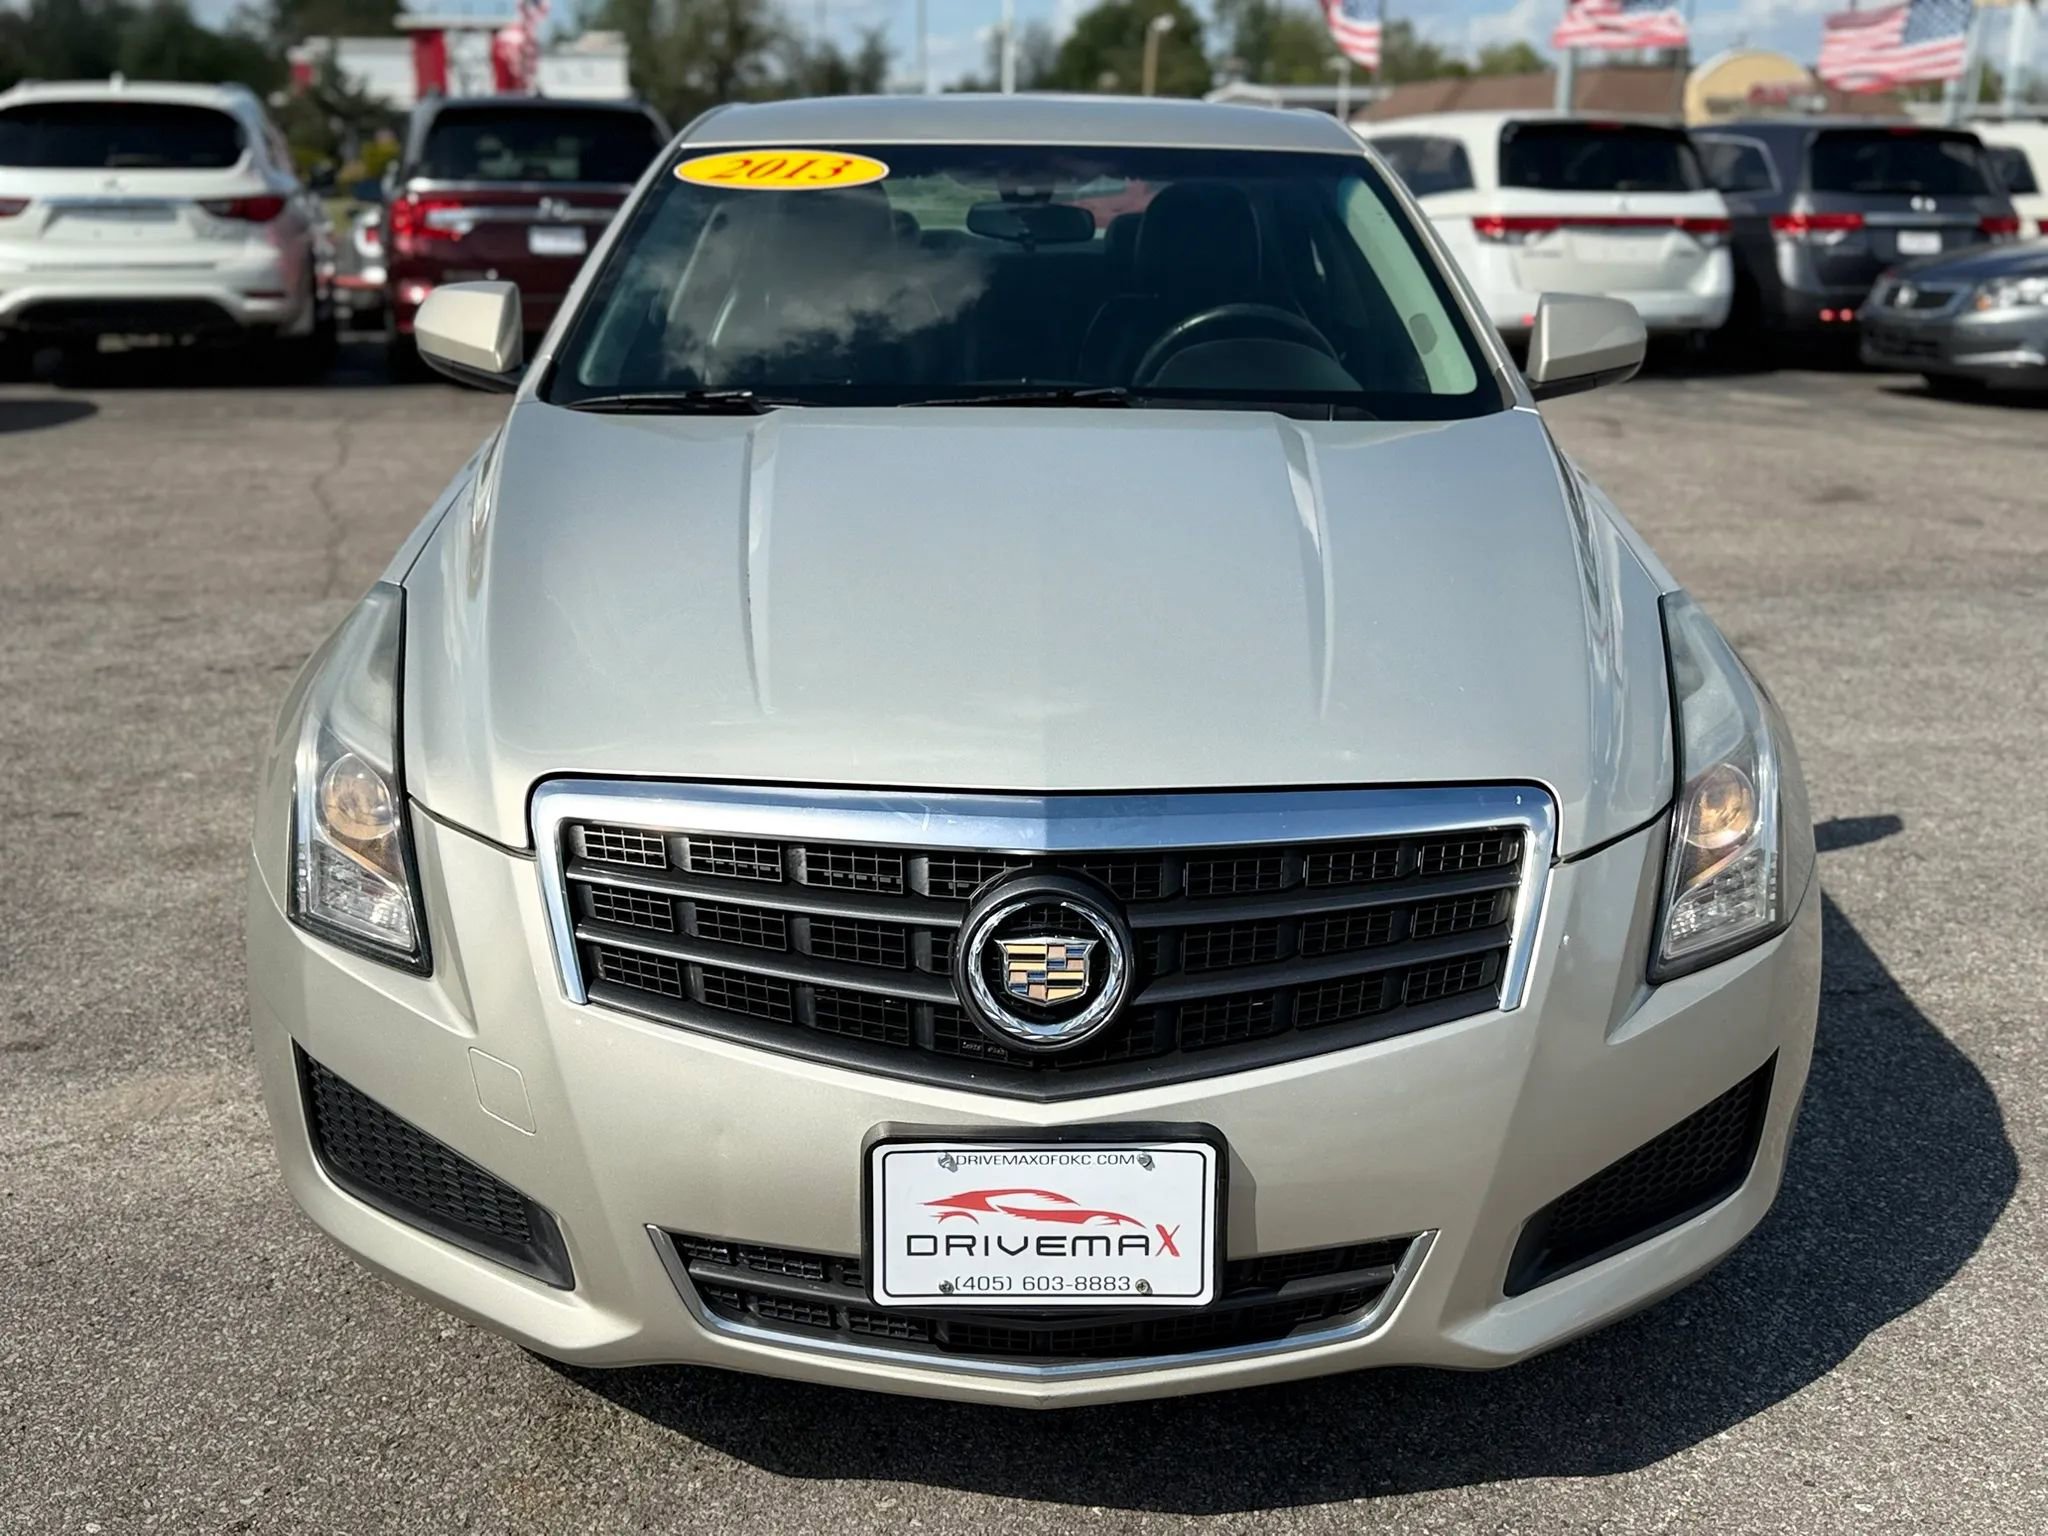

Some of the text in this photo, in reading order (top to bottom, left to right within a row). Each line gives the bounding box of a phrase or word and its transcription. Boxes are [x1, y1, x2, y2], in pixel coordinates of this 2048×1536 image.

[708, 159, 854, 180] 2013
[906, 1224, 1181, 1258] DRIVEMAX
[955, 1276, 1131, 1291] (405) 603-8883
